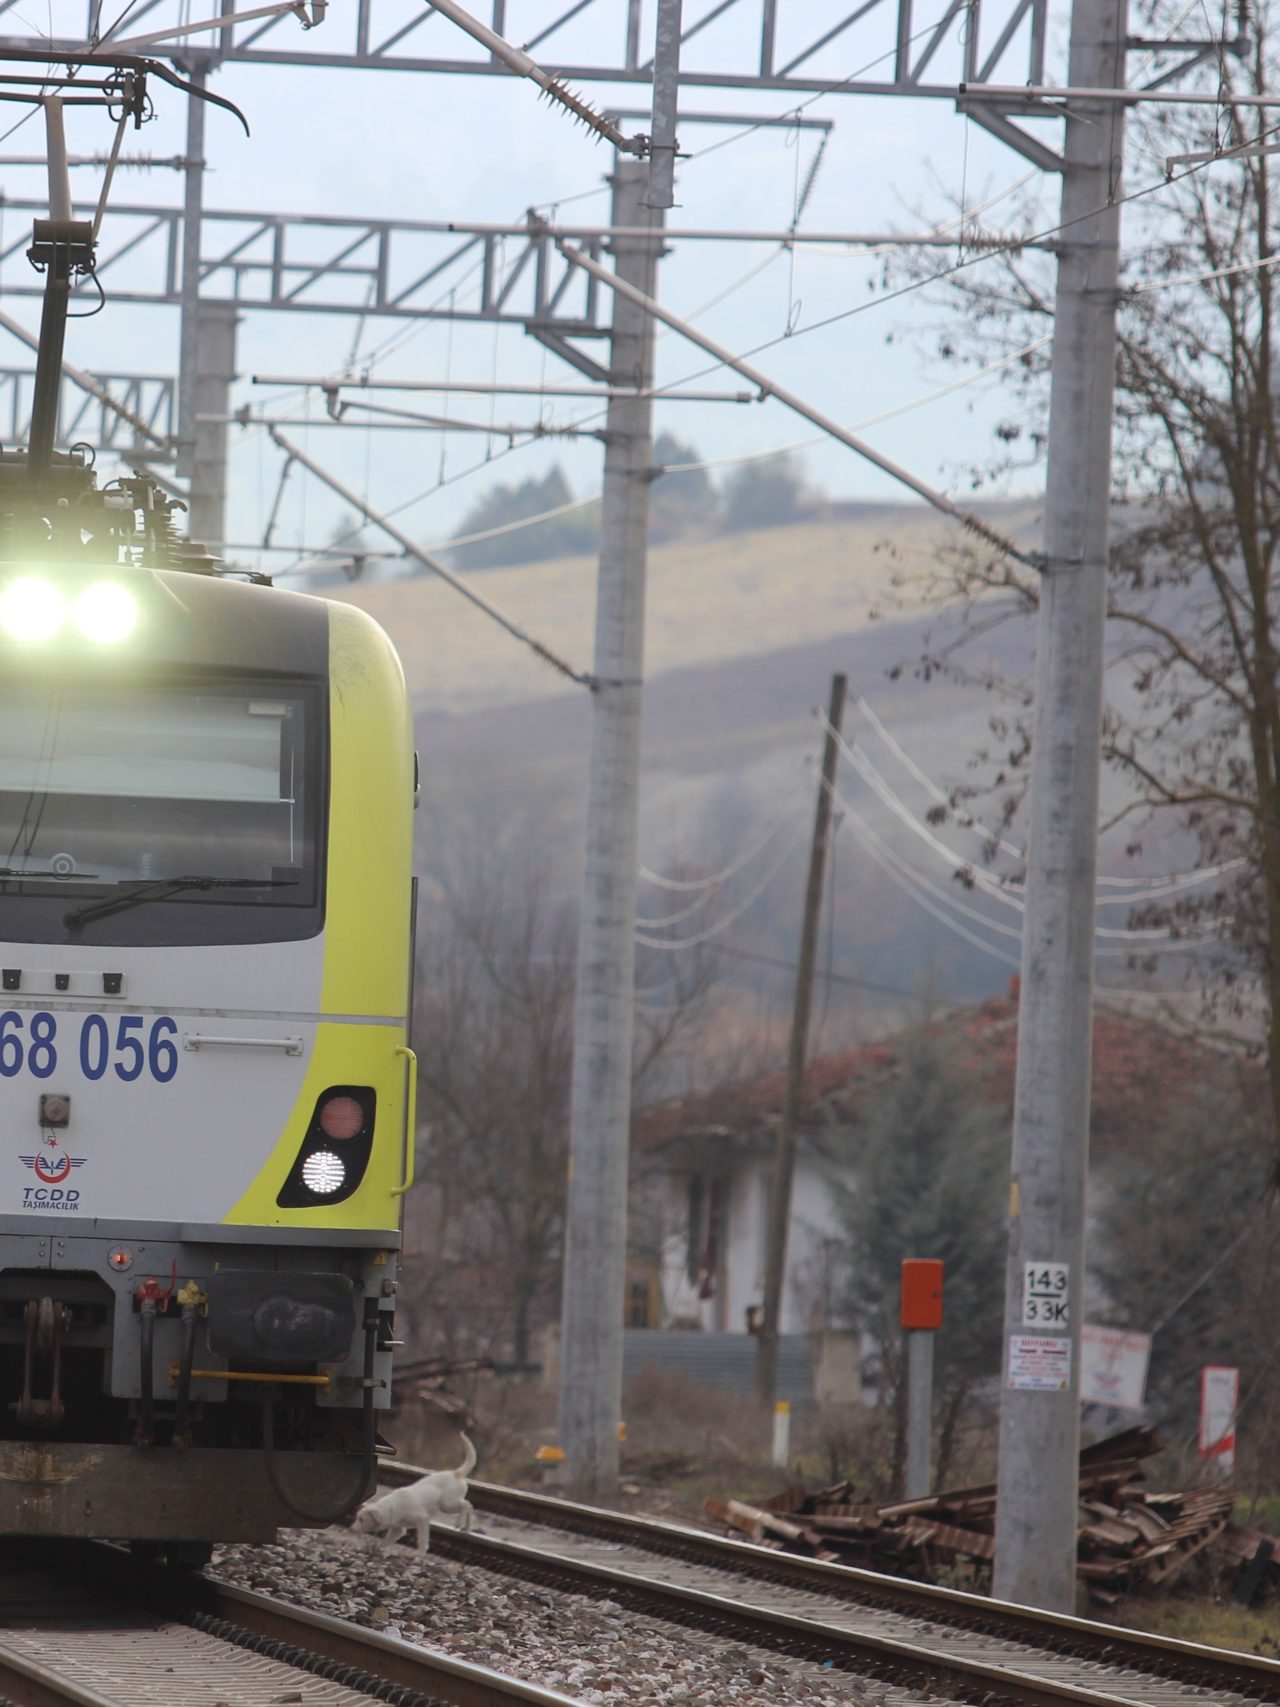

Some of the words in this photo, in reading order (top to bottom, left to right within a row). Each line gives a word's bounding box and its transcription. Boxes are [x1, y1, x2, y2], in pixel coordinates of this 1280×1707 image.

[80, 1014, 179, 1083] 056
[23, 1188, 80, 1202] TCDD
[22, 1200, 79, 1211] TAŞIMACILIK
[1027, 1269, 1067, 1290] 143
